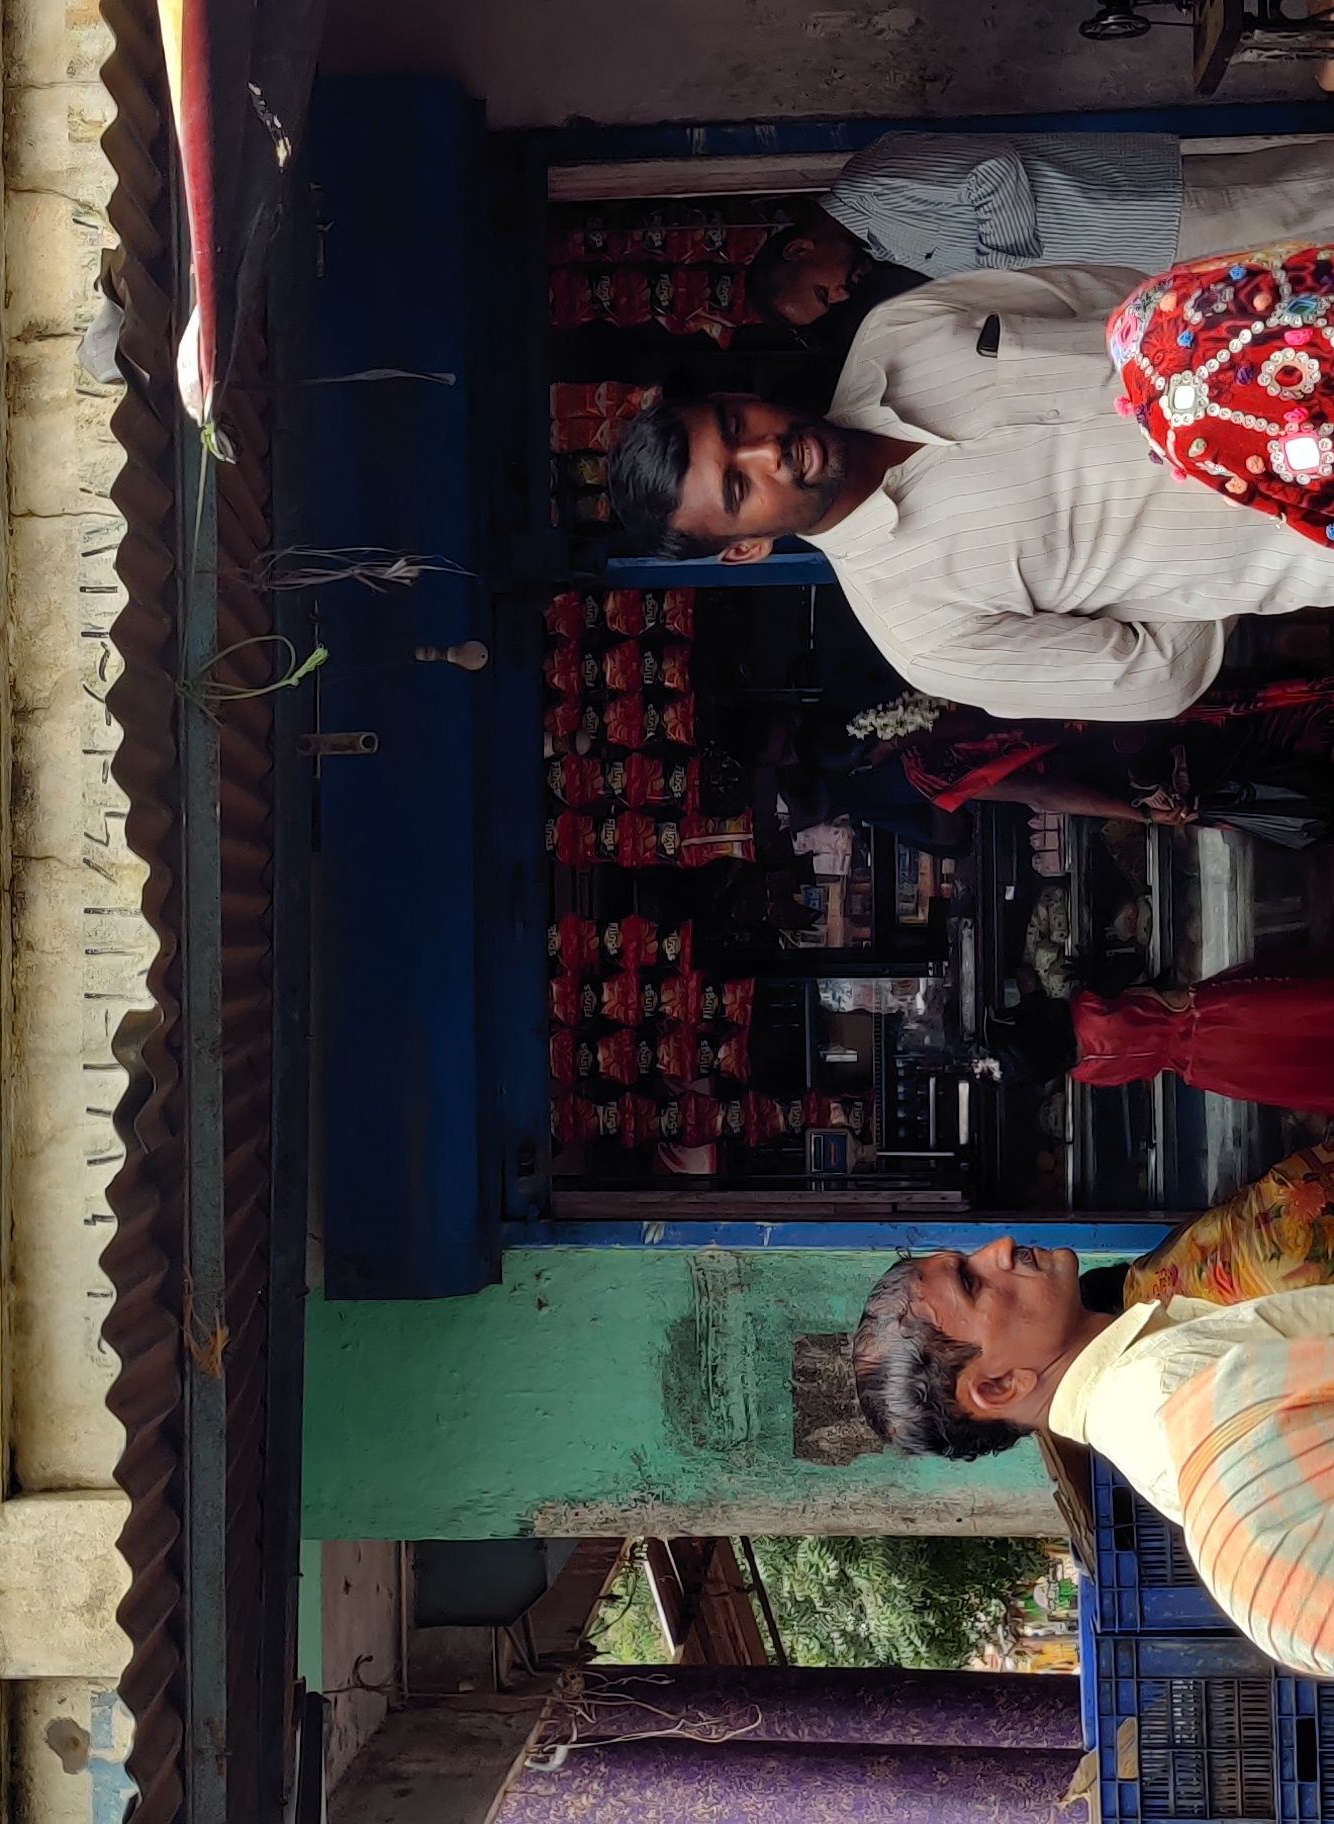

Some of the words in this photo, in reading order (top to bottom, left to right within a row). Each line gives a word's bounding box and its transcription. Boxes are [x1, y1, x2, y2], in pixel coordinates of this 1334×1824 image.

[643, 651, 654, 683] Flings
[582, 983, 594, 1017] Flings
[643, 984, 654, 1017] Flings
[702, 985, 714, 1019] Flings
[578, 1042, 590, 1076] Flings
[699, 1040, 711, 1074] Flings
